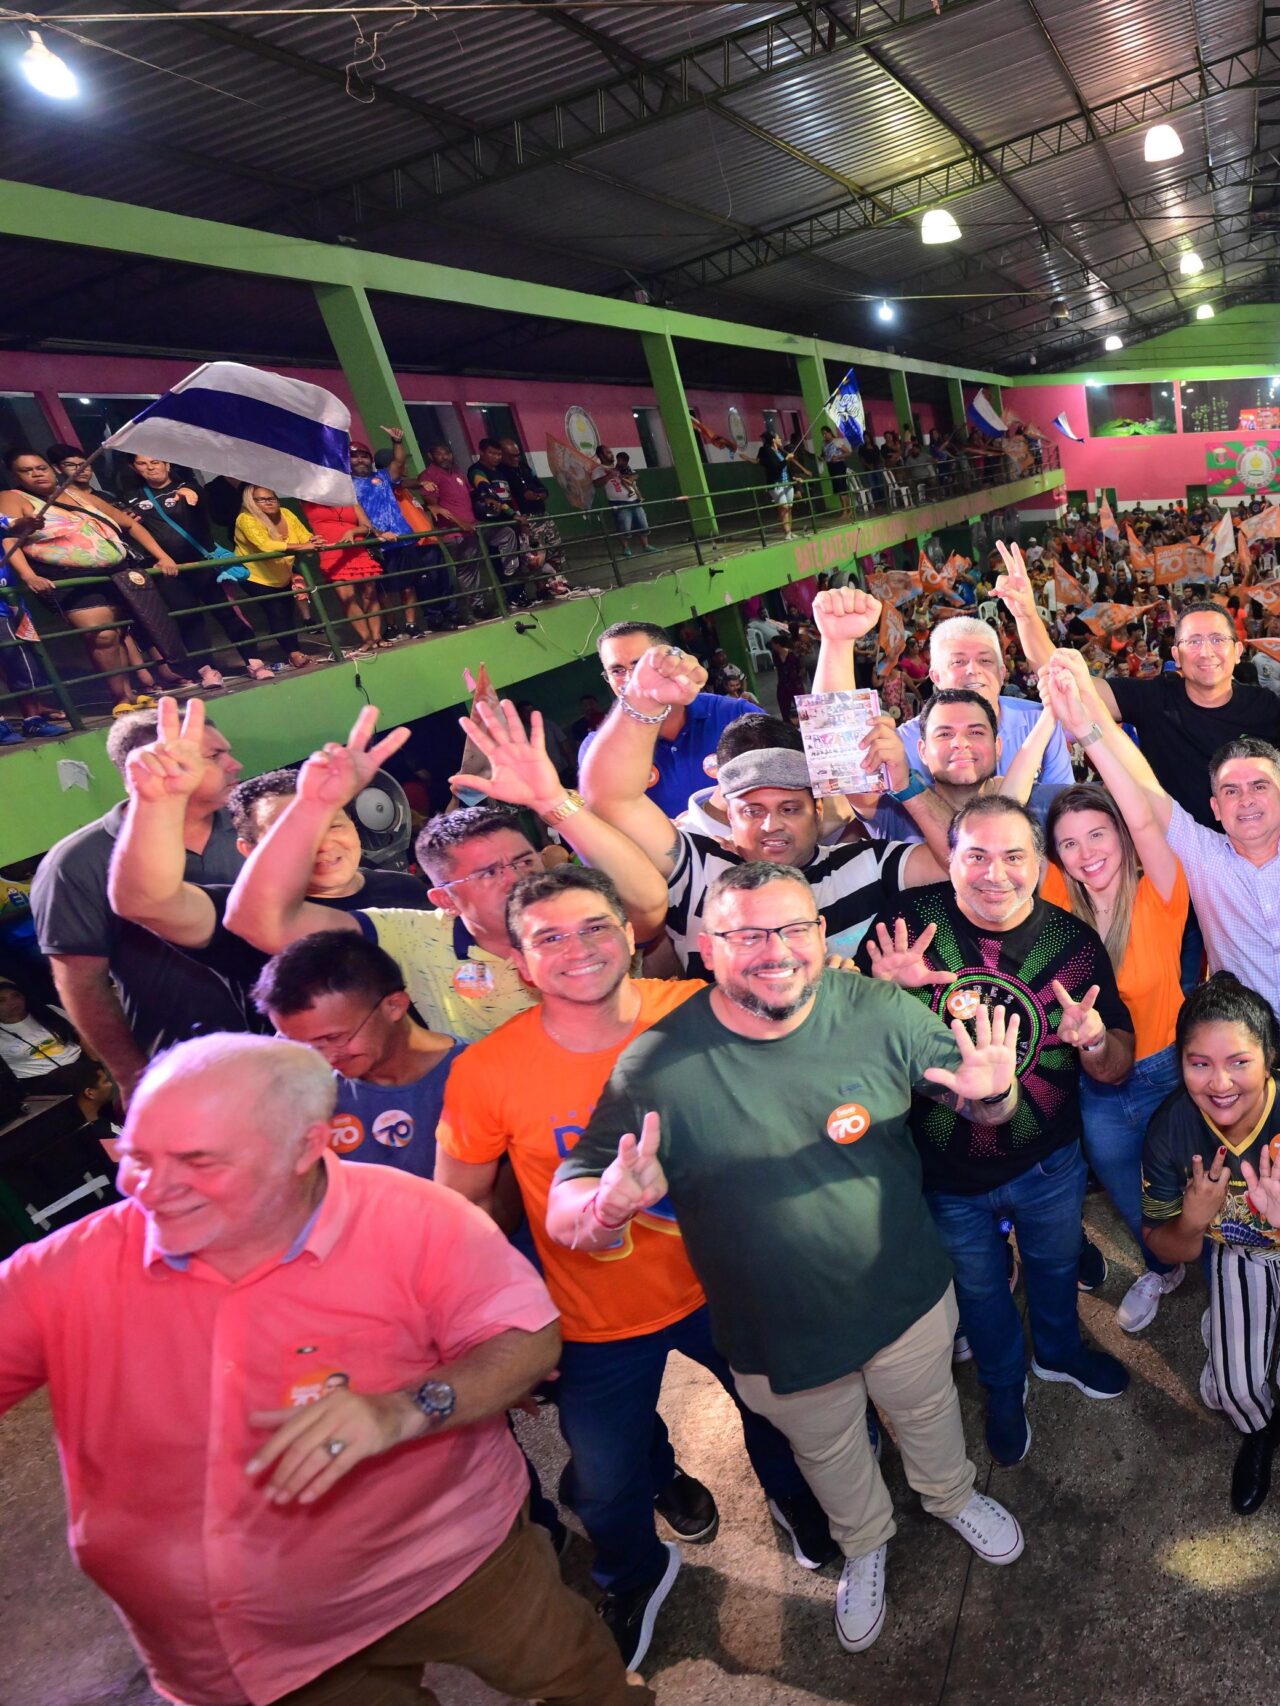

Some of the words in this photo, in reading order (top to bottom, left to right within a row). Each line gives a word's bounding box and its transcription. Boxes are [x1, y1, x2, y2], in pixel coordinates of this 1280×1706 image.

[1160, 557, 1184, 574] 70
[330, 1126, 359, 1146] 70
[377, 1121, 410, 1144] 70
[832, 1115, 865, 1138] 70
